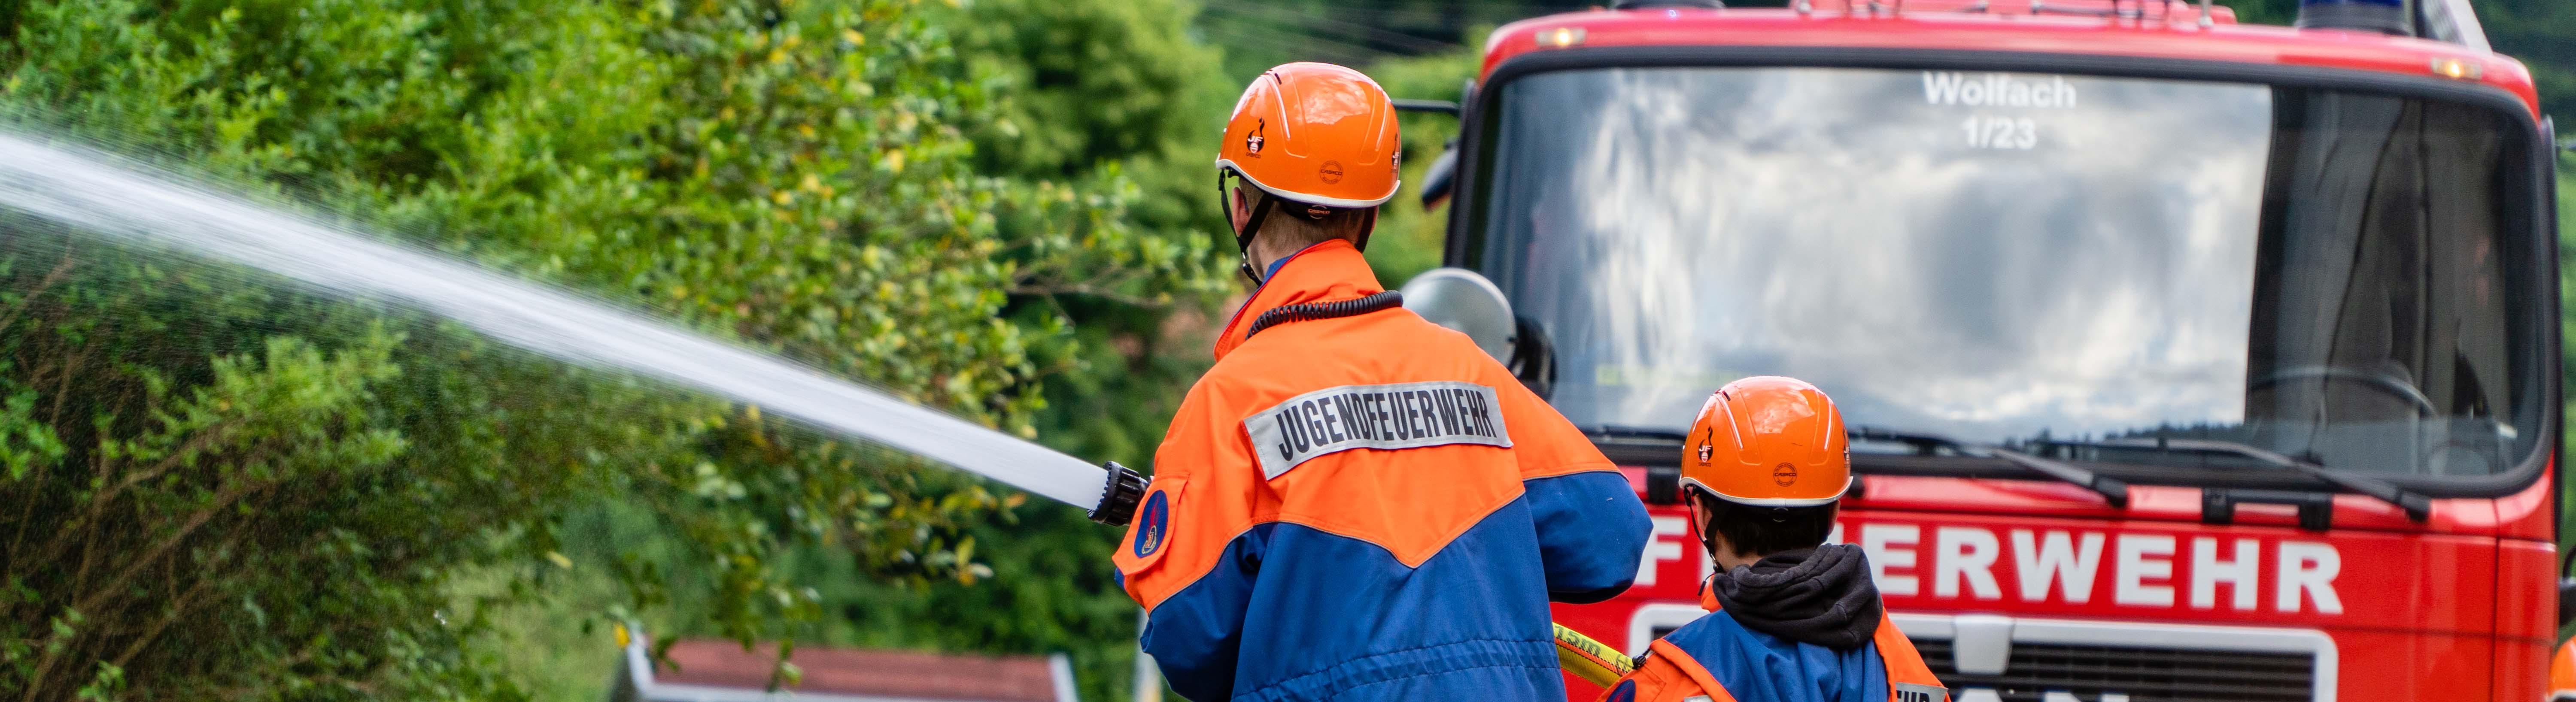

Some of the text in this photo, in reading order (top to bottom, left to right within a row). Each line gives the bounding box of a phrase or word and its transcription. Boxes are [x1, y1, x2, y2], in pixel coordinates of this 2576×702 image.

[1923, 71, 2076, 108] Wolfach
[1962, 115, 2037, 149] 1/23
[1276, 388, 1497, 461] JUGENDFEUERWEHR
[1633, 516, 2344, 613] FERWEHR
